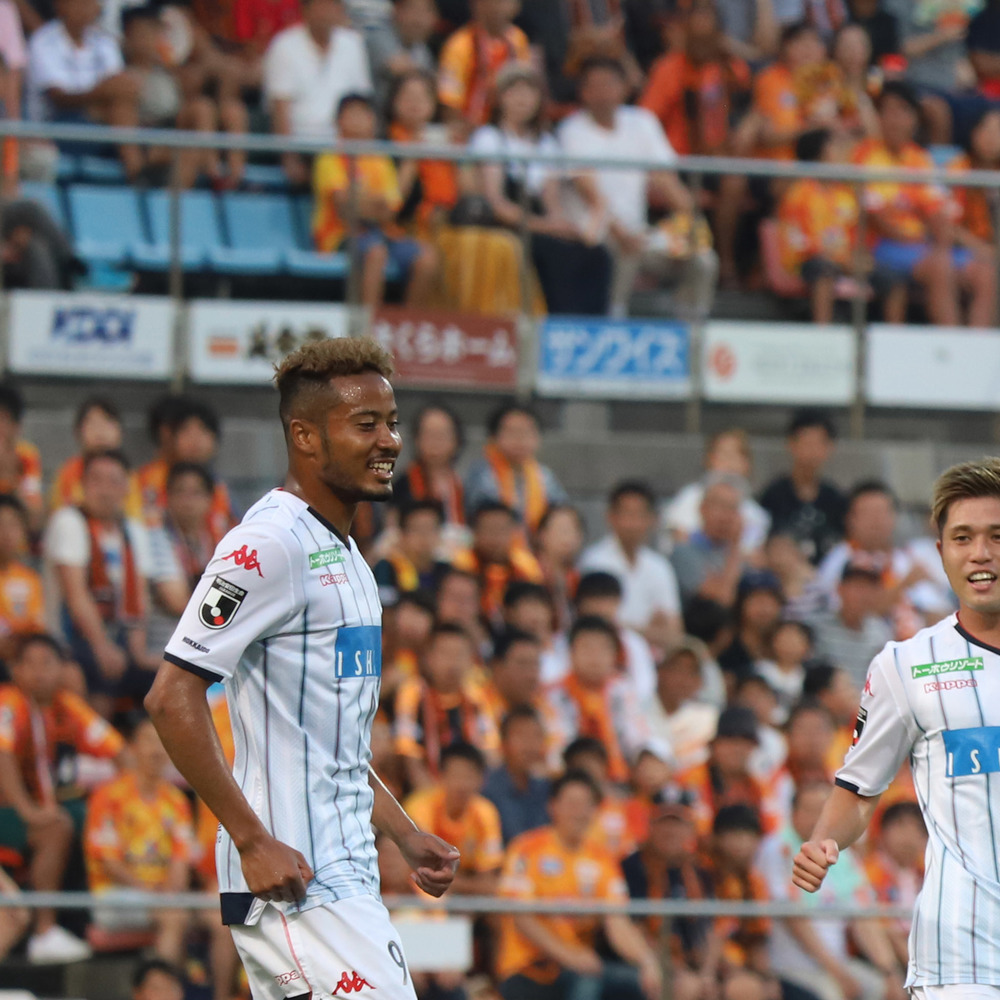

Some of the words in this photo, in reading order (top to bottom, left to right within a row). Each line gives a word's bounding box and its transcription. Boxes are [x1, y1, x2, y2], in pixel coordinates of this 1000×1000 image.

[913, 659, 983, 678] トーホウリゾート
[924, 678, 978, 694] Kappa
[387, 940, 407, 986] 9
